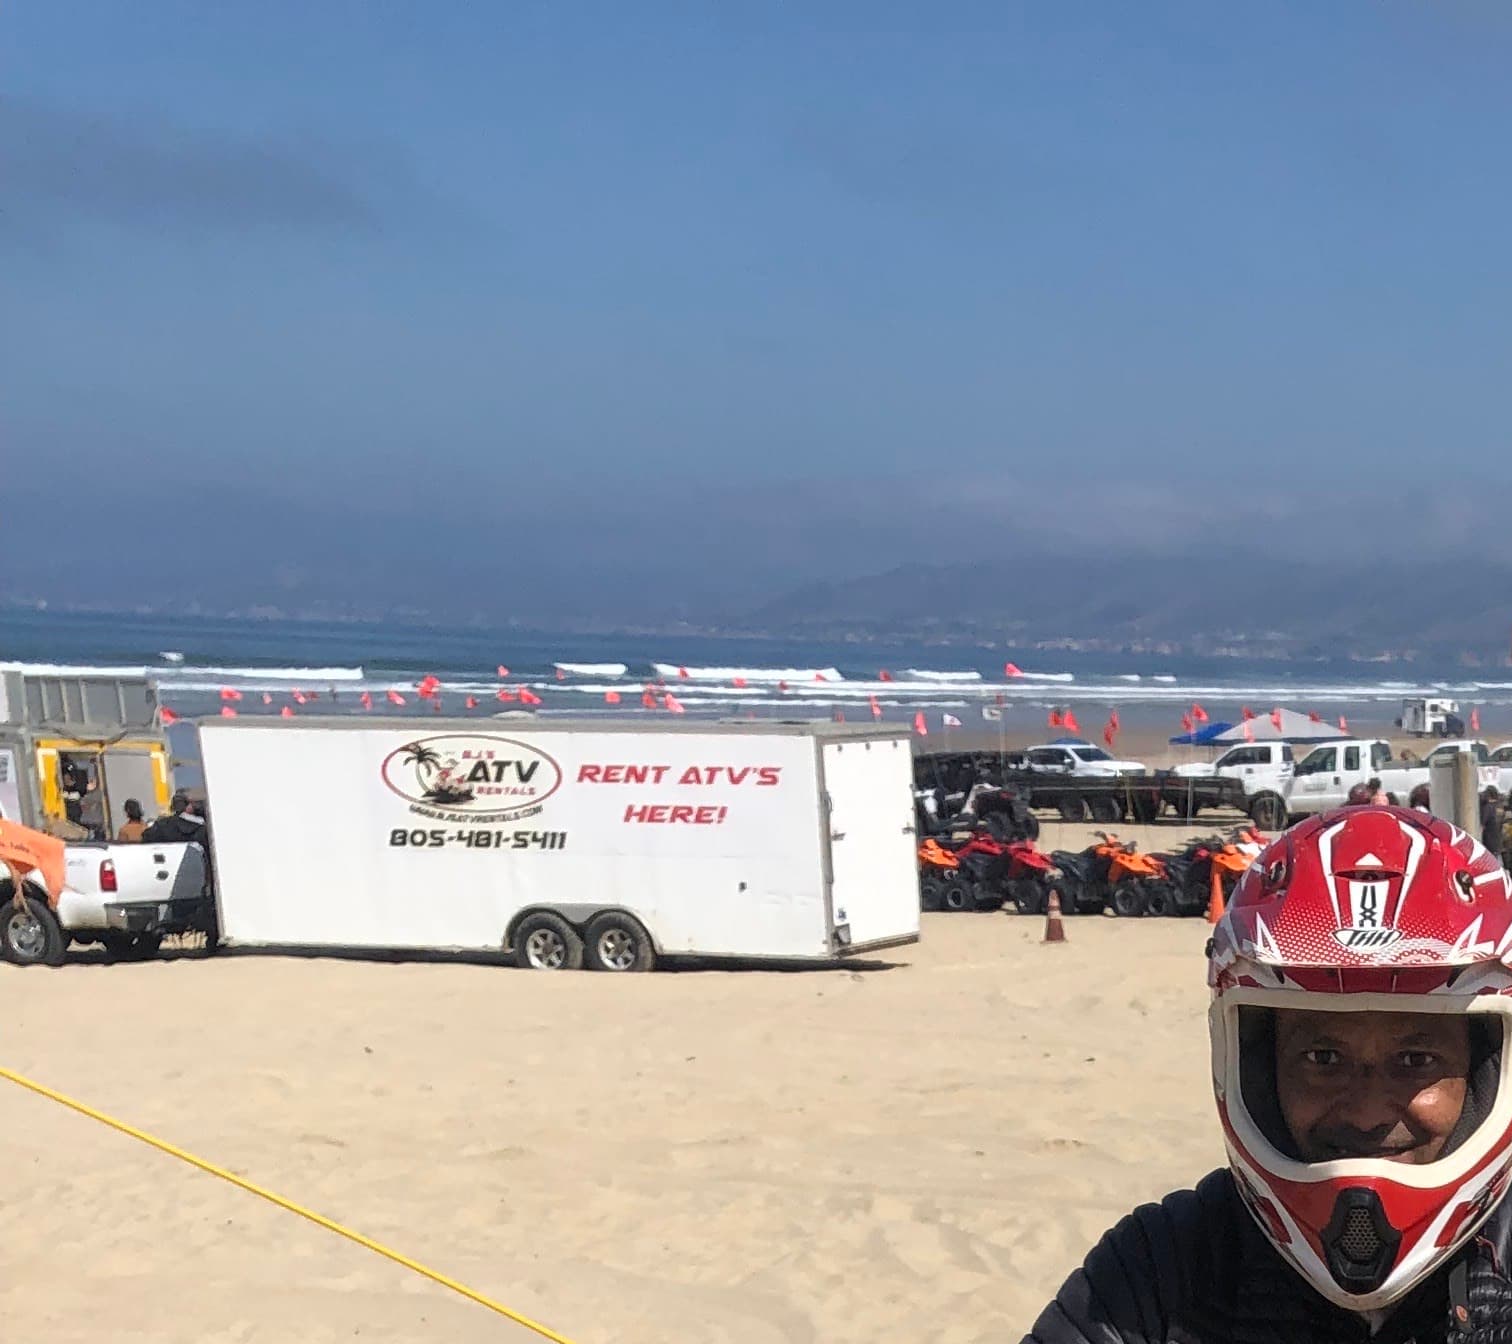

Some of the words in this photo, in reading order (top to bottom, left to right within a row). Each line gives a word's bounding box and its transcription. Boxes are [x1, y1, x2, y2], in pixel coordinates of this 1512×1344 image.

[466, 760, 540, 783] ATV
[576, 764, 671, 783] RENT
[678, 766, 784, 786] ATV'S
[476, 786, 537, 796] RENTALS
[623, 804, 729, 825] HERE!
[389, 829, 568, 850] 805-481-5411
